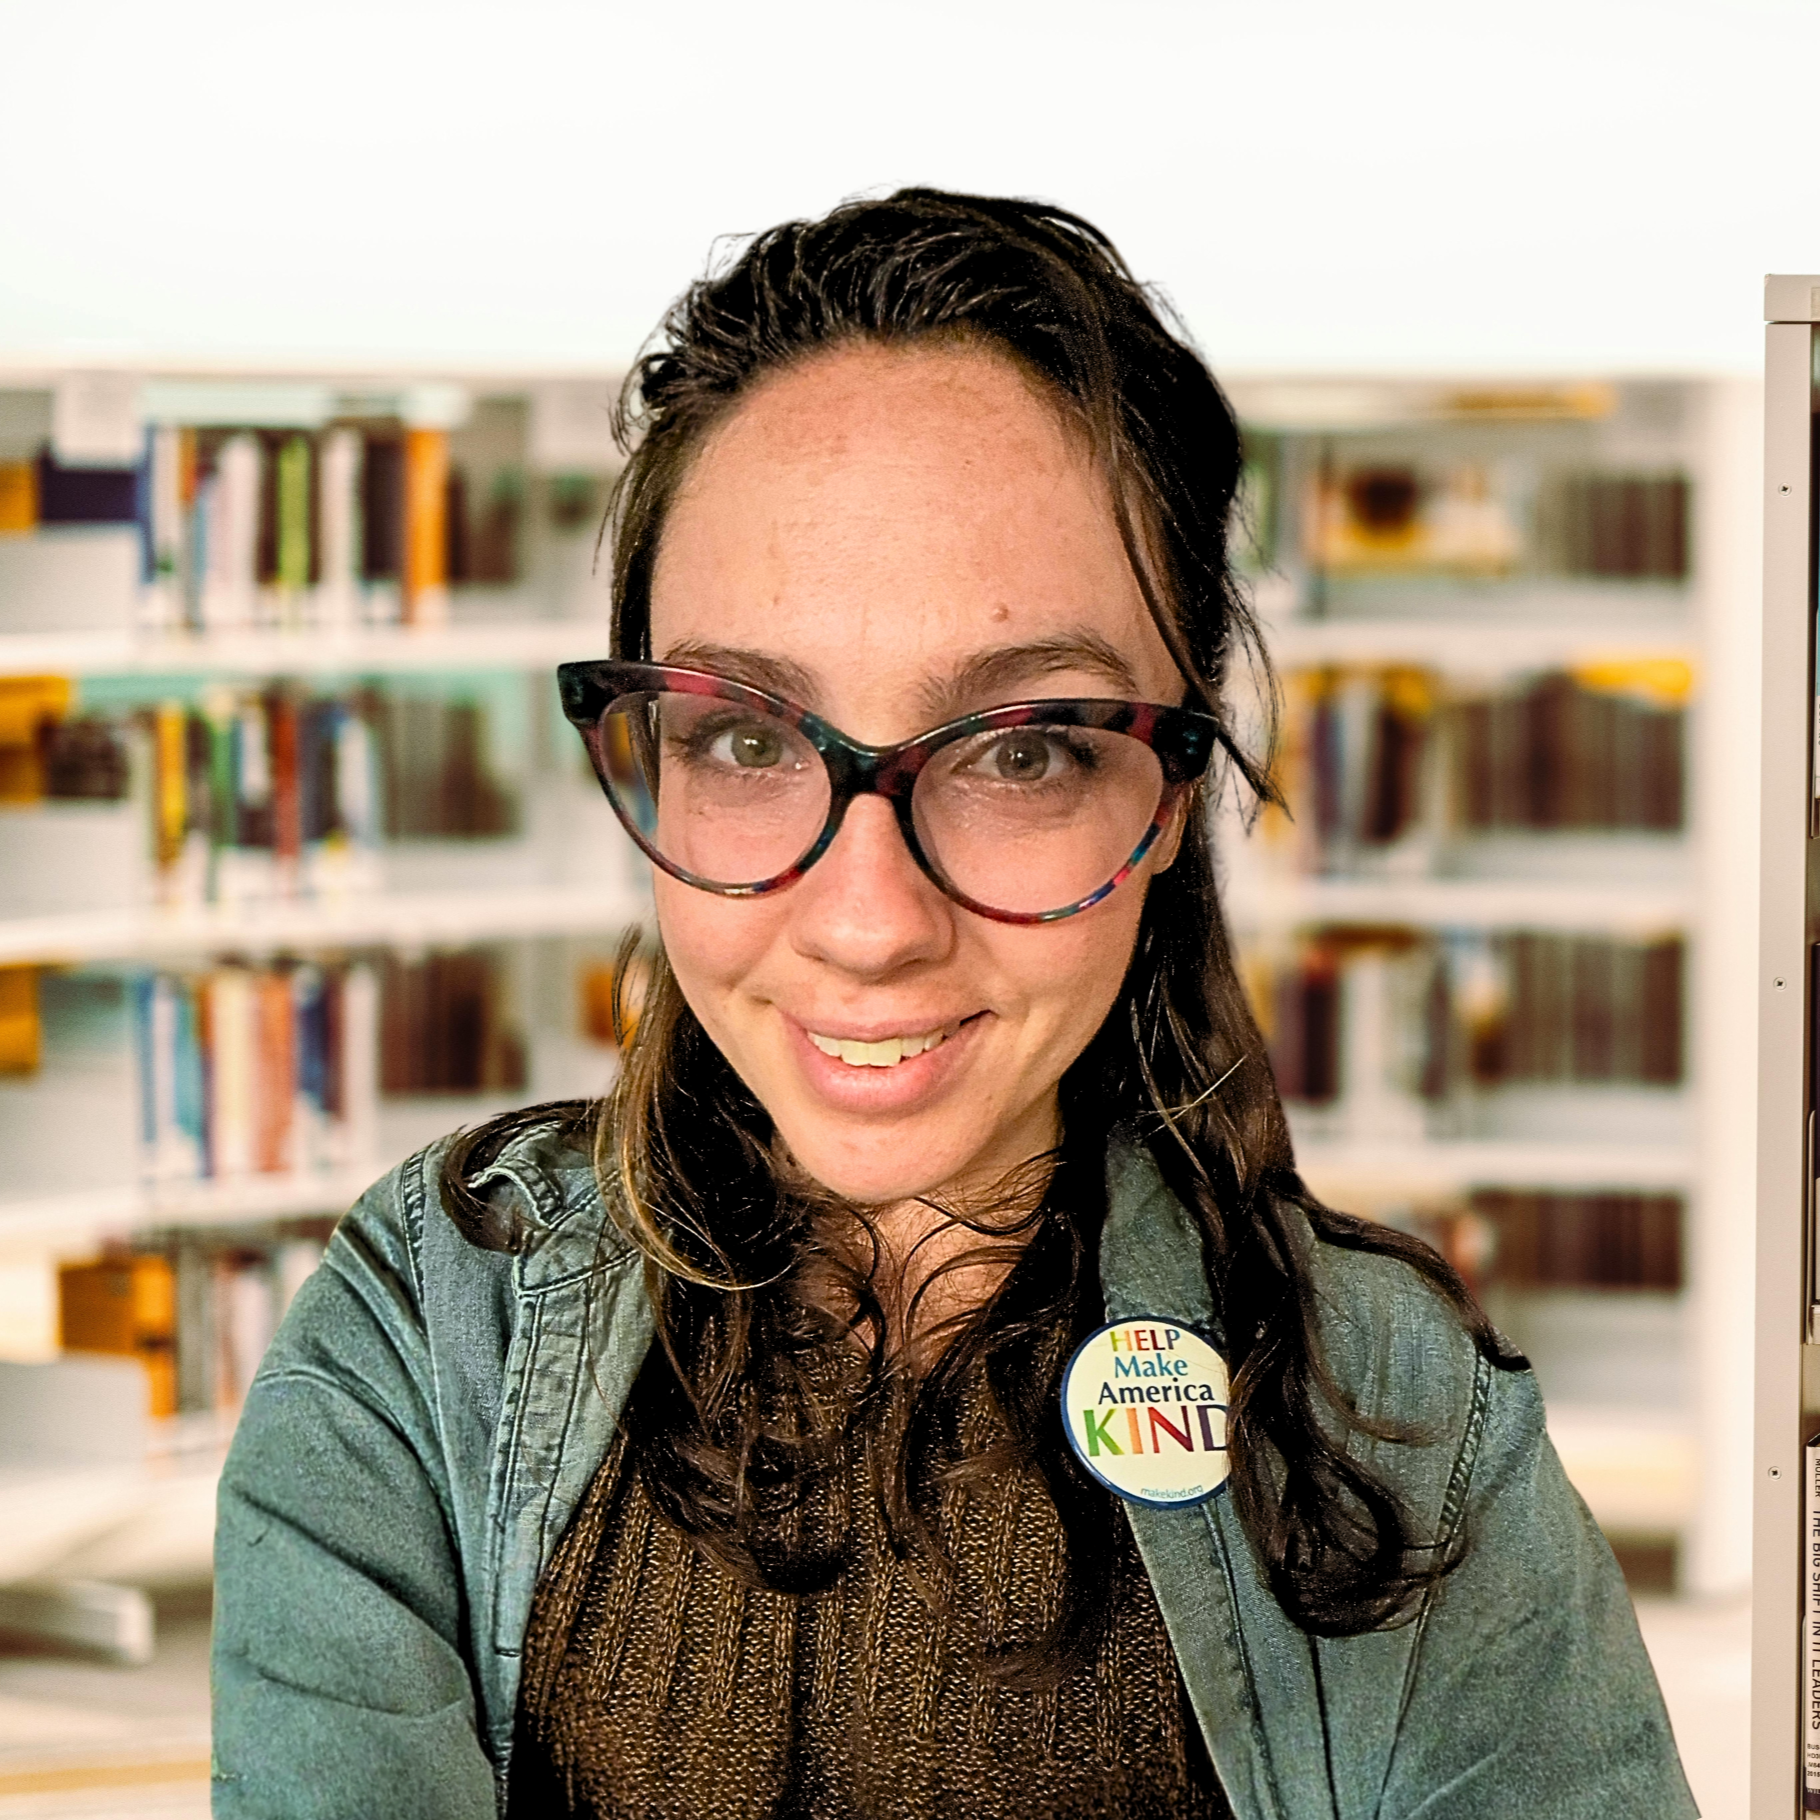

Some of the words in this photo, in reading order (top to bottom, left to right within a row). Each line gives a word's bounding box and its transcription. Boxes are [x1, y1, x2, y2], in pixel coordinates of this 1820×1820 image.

[1109, 1329, 1180, 1352] HELP
[1114, 1353, 1188, 1378] Make
[1098, 1377, 1215, 1405] America
[1083, 1404, 1229, 1457] KIND
[1140, 1485, 1203, 1499] makekind.org
